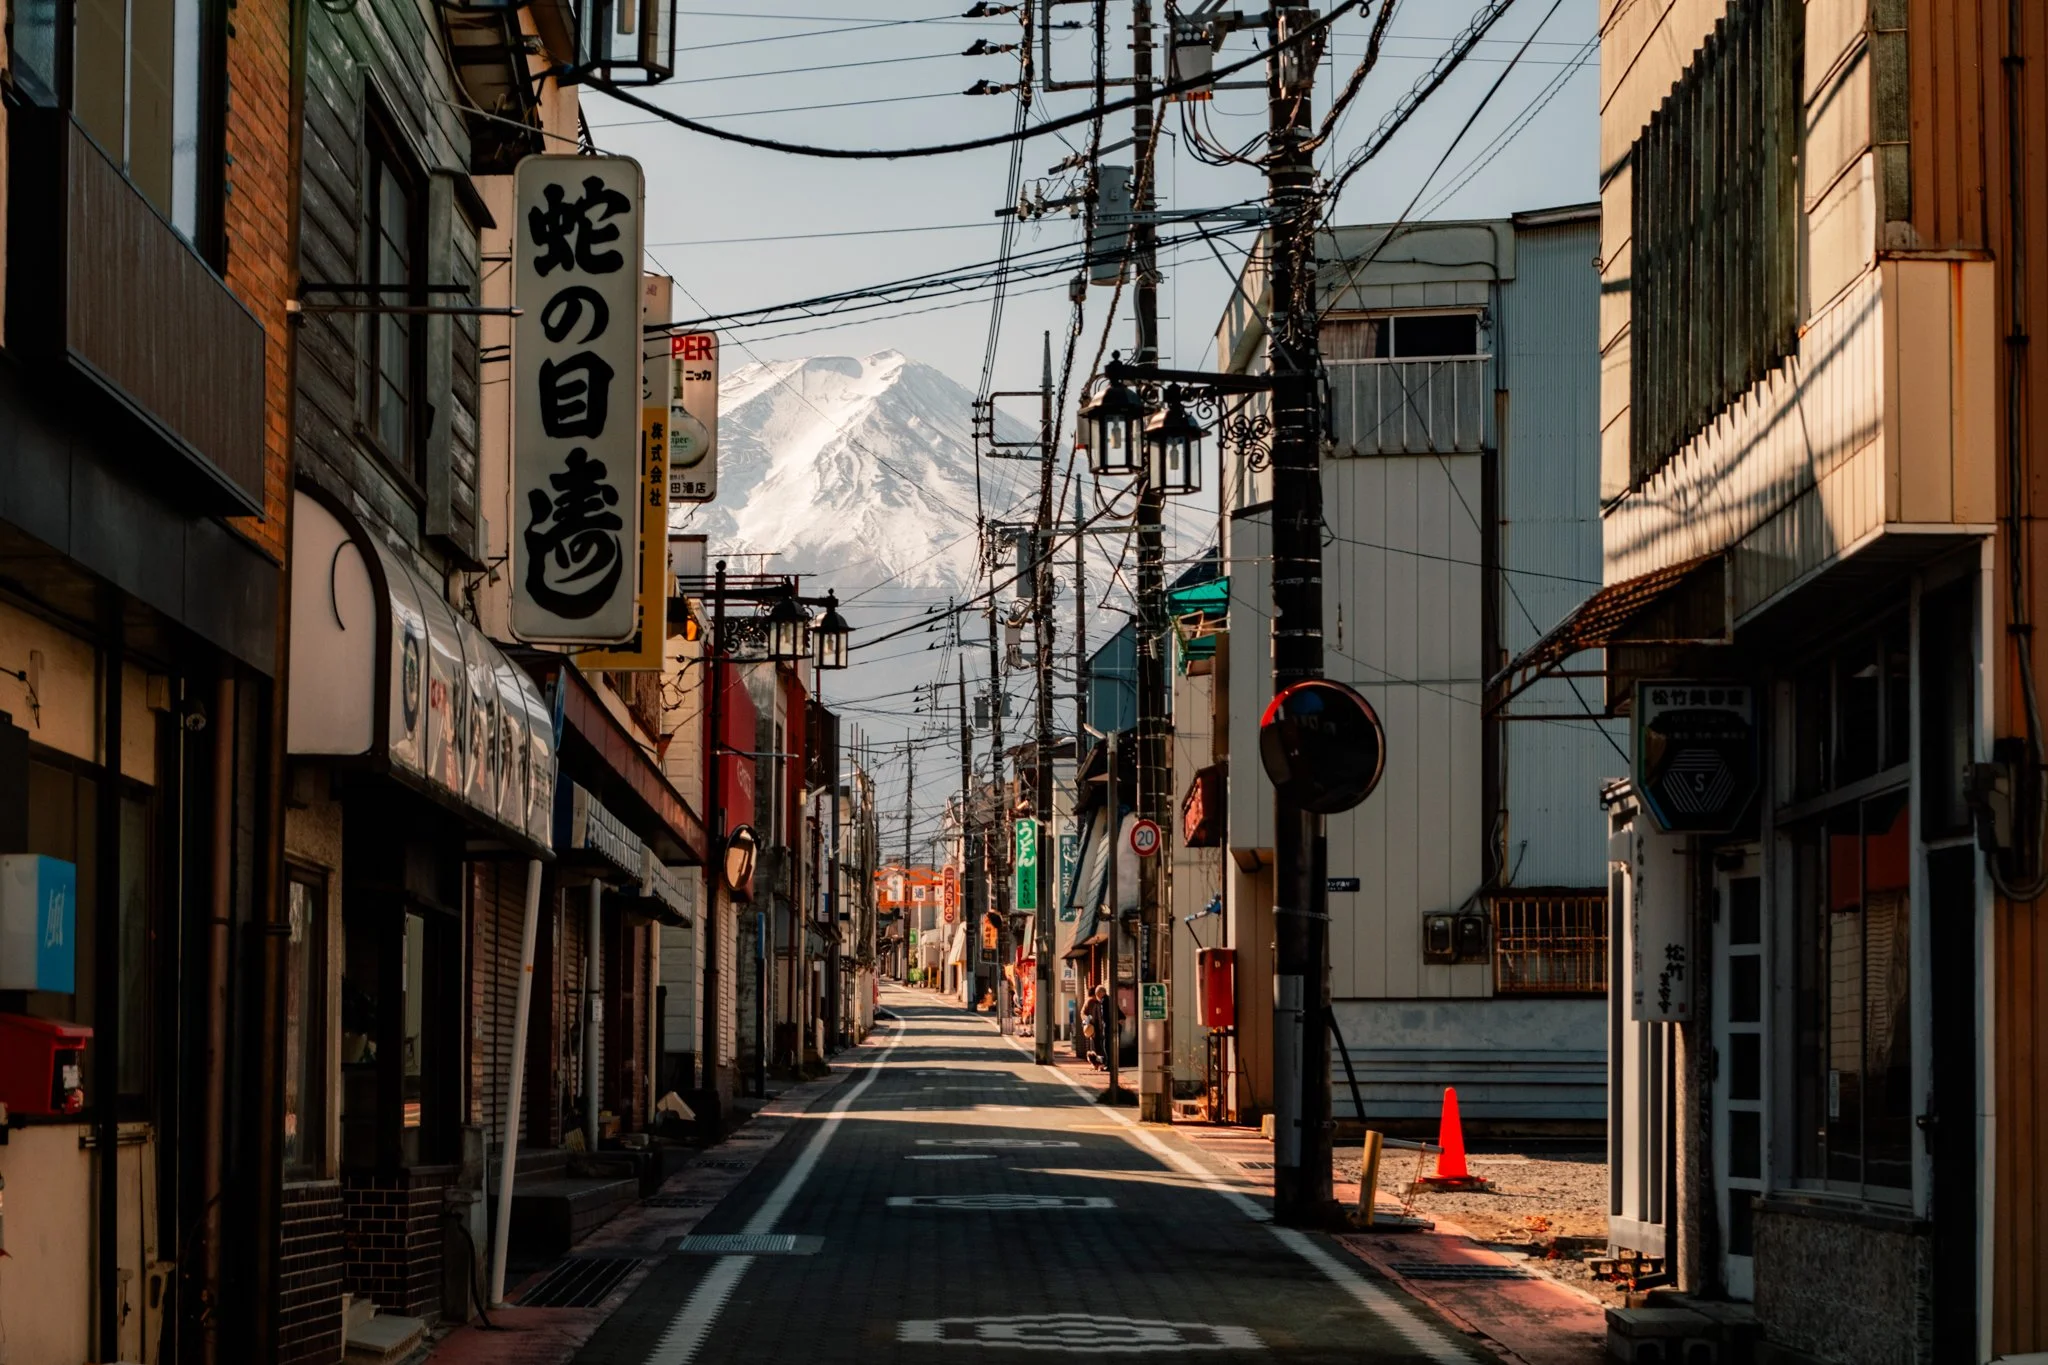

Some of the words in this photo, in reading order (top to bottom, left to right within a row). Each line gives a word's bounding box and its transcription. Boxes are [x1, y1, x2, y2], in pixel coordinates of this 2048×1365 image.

[685, 370, 712, 381] ニッカ
[649, 421, 664, 507] 株式会社
[1694, 773, 1706, 792] S
[1018, 821, 1035, 868] うどん
[1137, 830, 1154, 846] 20
